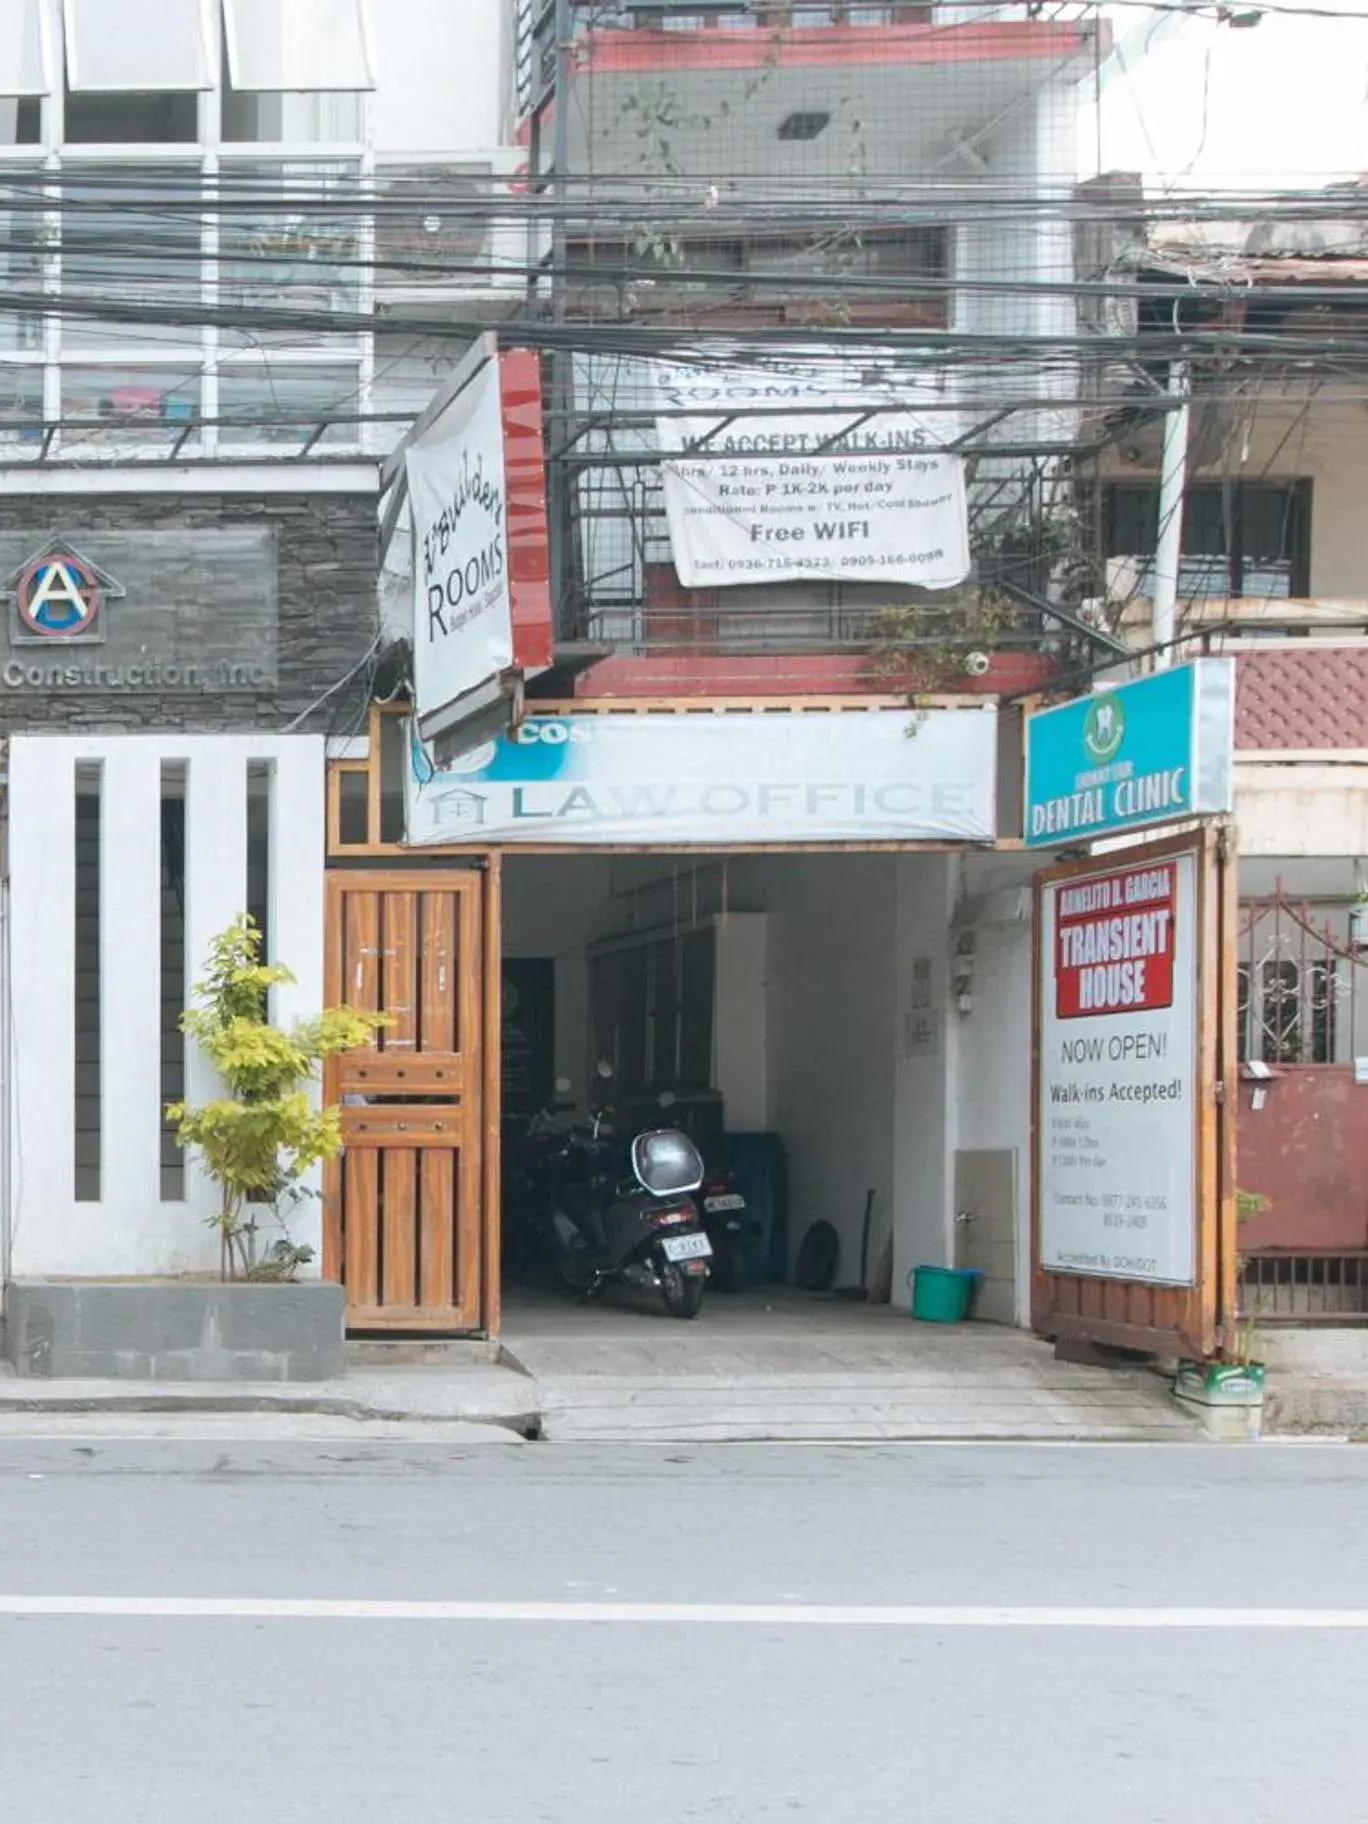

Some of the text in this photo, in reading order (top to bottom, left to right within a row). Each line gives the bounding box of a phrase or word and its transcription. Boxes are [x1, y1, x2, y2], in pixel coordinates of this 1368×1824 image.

[724, 432, 809, 452] ACCEPT
[832, 460, 893, 475] Weekly
[896, 458, 939, 473] Stays
[833, 482, 860, 496] per
[864, 479, 894, 494] day
[751, 520, 869, 542] Free WIFI
[428, 533, 503, 643] ROOMS
[511, 781, 976, 819] LAW OFFICE
[1033, 786, 1105, 838] DENTAL
[1114, 766, 1185, 818] CLINIC
[1125, 867, 1171, 904] GARCIA
[1059, 908, 1171, 969] TRANSIENT
[1079, 959, 1146, 1010] HOUSE
[1061, 1031, 1168, 1064] NOW OPEN!
[1049, 1078, 1182, 1105] Walk-ins Accepted!
